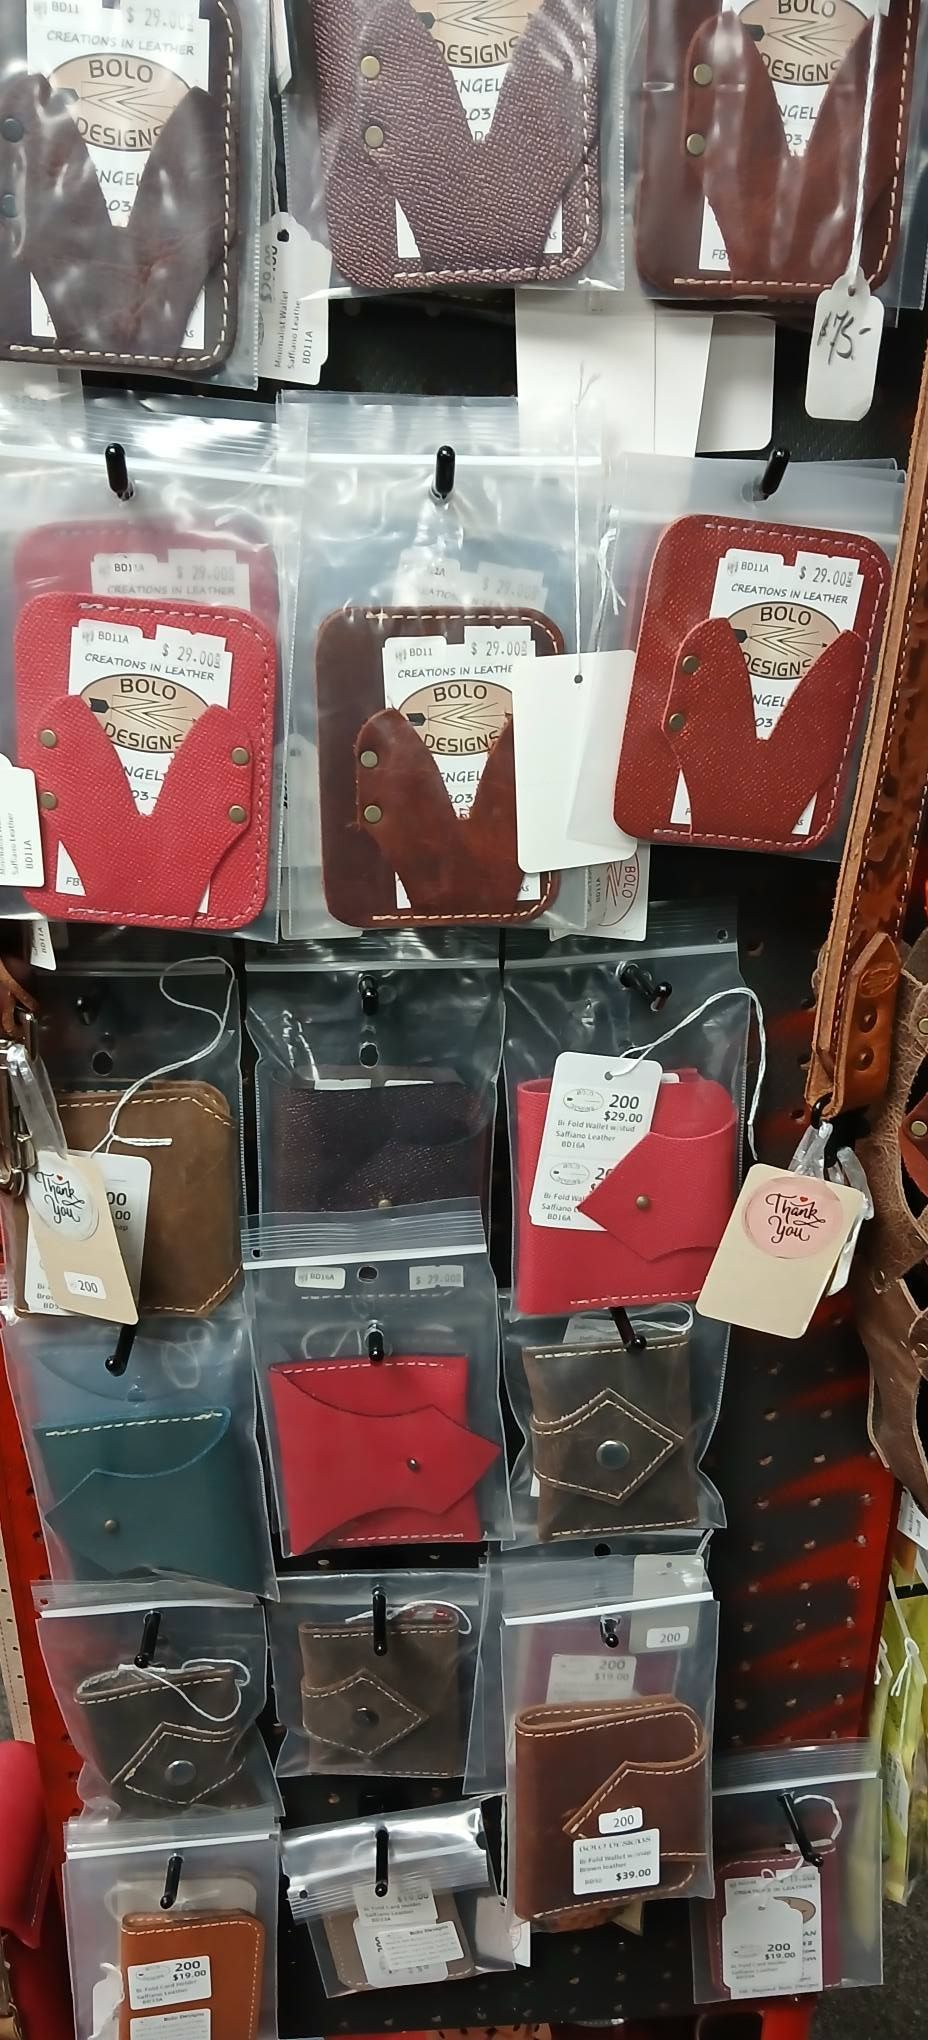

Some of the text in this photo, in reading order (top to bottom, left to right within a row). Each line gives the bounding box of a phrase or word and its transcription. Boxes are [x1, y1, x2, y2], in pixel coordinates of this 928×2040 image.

[47, 30, 194, 56] CREATIONS IN LEATHER
[89, 59, 153, 84] BOLO
[291, 300, 302, 332] Leathe
[301, 330, 313, 365] BD11A
[740, 562, 769, 573] BD11A
[107, 584, 235, 596] CREATIONS IN LEATHER
[731, 583, 848, 605] CREATIONS IN LEATHER
[760, 606, 812, 626] BOLO
[98, 631, 129, 645] BD11A
[409, 648, 433, 658] BD11
[84, 653, 215, 681] CREATIONS IN LEATHER
[397, 664, 513, 679] CREATIONS IN LEATHE
[120, 678, 177, 700] BOLO
[433, 684, 487, 702] BOLO
[621, 865, 637, 899] BOLO
[609, 1094, 640, 1110] 200
[603, 1111, 643, 1123] $29.00
[567, 1121, 584, 1129] Fold
[586, 1122, 609, 1131] Wallet
[556, 1131, 616, 1142] Saffiano Leather
[34, 1171, 85, 1208] Thank
[553, 1192, 570, 1201] Fold
[571, 1194, 585, 1202] Wal
[44, 1194, 80, 1224] You
[542, 1203, 572, 1213] Saffiano
[765, 1193, 826, 1229] Thank
[768, 1215, 810, 1244] You
[77, 1280, 98, 1294] 200
[660, 1632, 681, 1644] 200
[599, 1659, 626, 1671] 200
[613, 1814, 635, 1828] 200
[615, 1867, 652, 1882] $39.00
[767, 1943, 791, 1952] 200
[765, 1952, 796, 1961] $19.00
[175, 1960, 201, 1972] 200
[172, 1969, 207, 1982] $19.00
